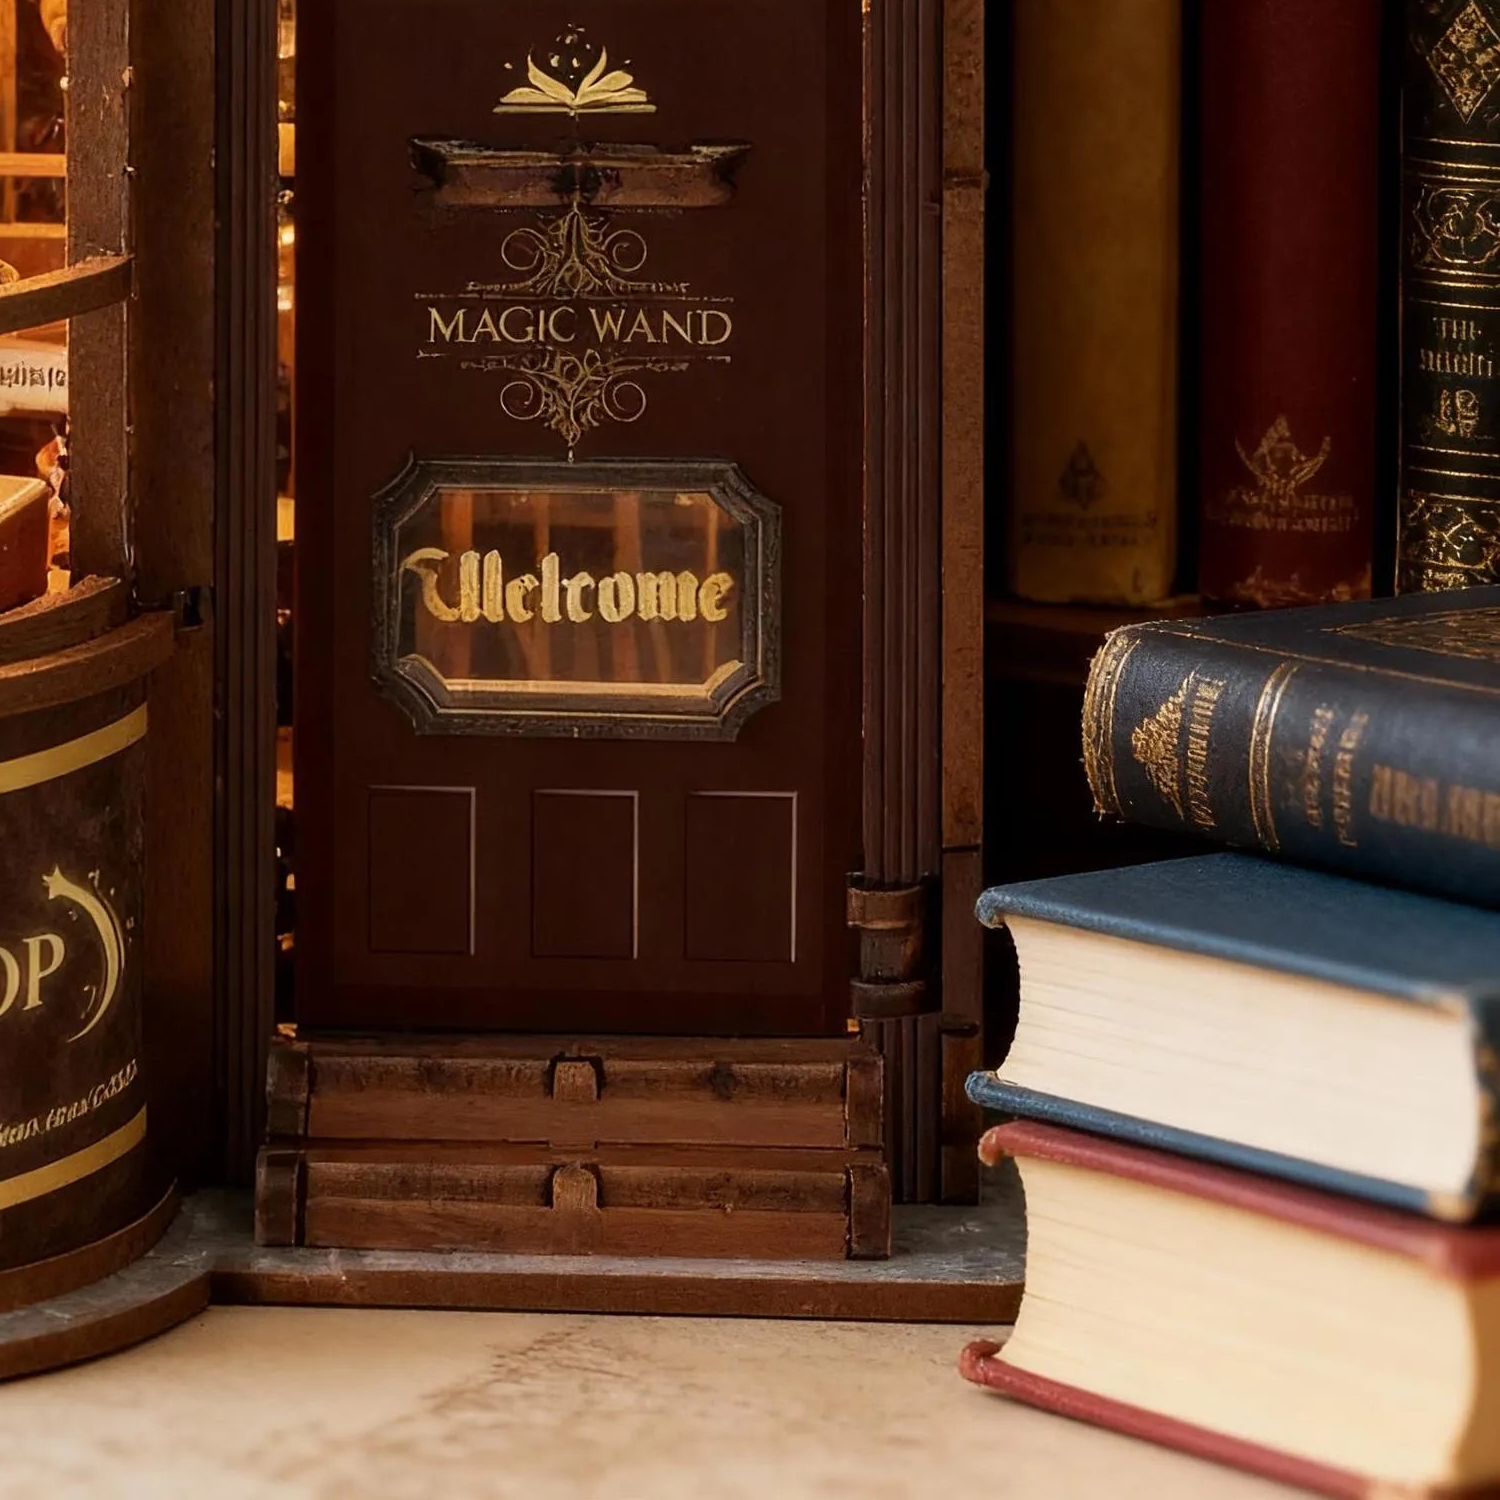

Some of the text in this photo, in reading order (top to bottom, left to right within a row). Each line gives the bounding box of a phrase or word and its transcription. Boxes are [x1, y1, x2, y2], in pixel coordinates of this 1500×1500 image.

[427, 306, 733, 346] MAGIC WAND
[402, 547, 734, 624] Welcome
